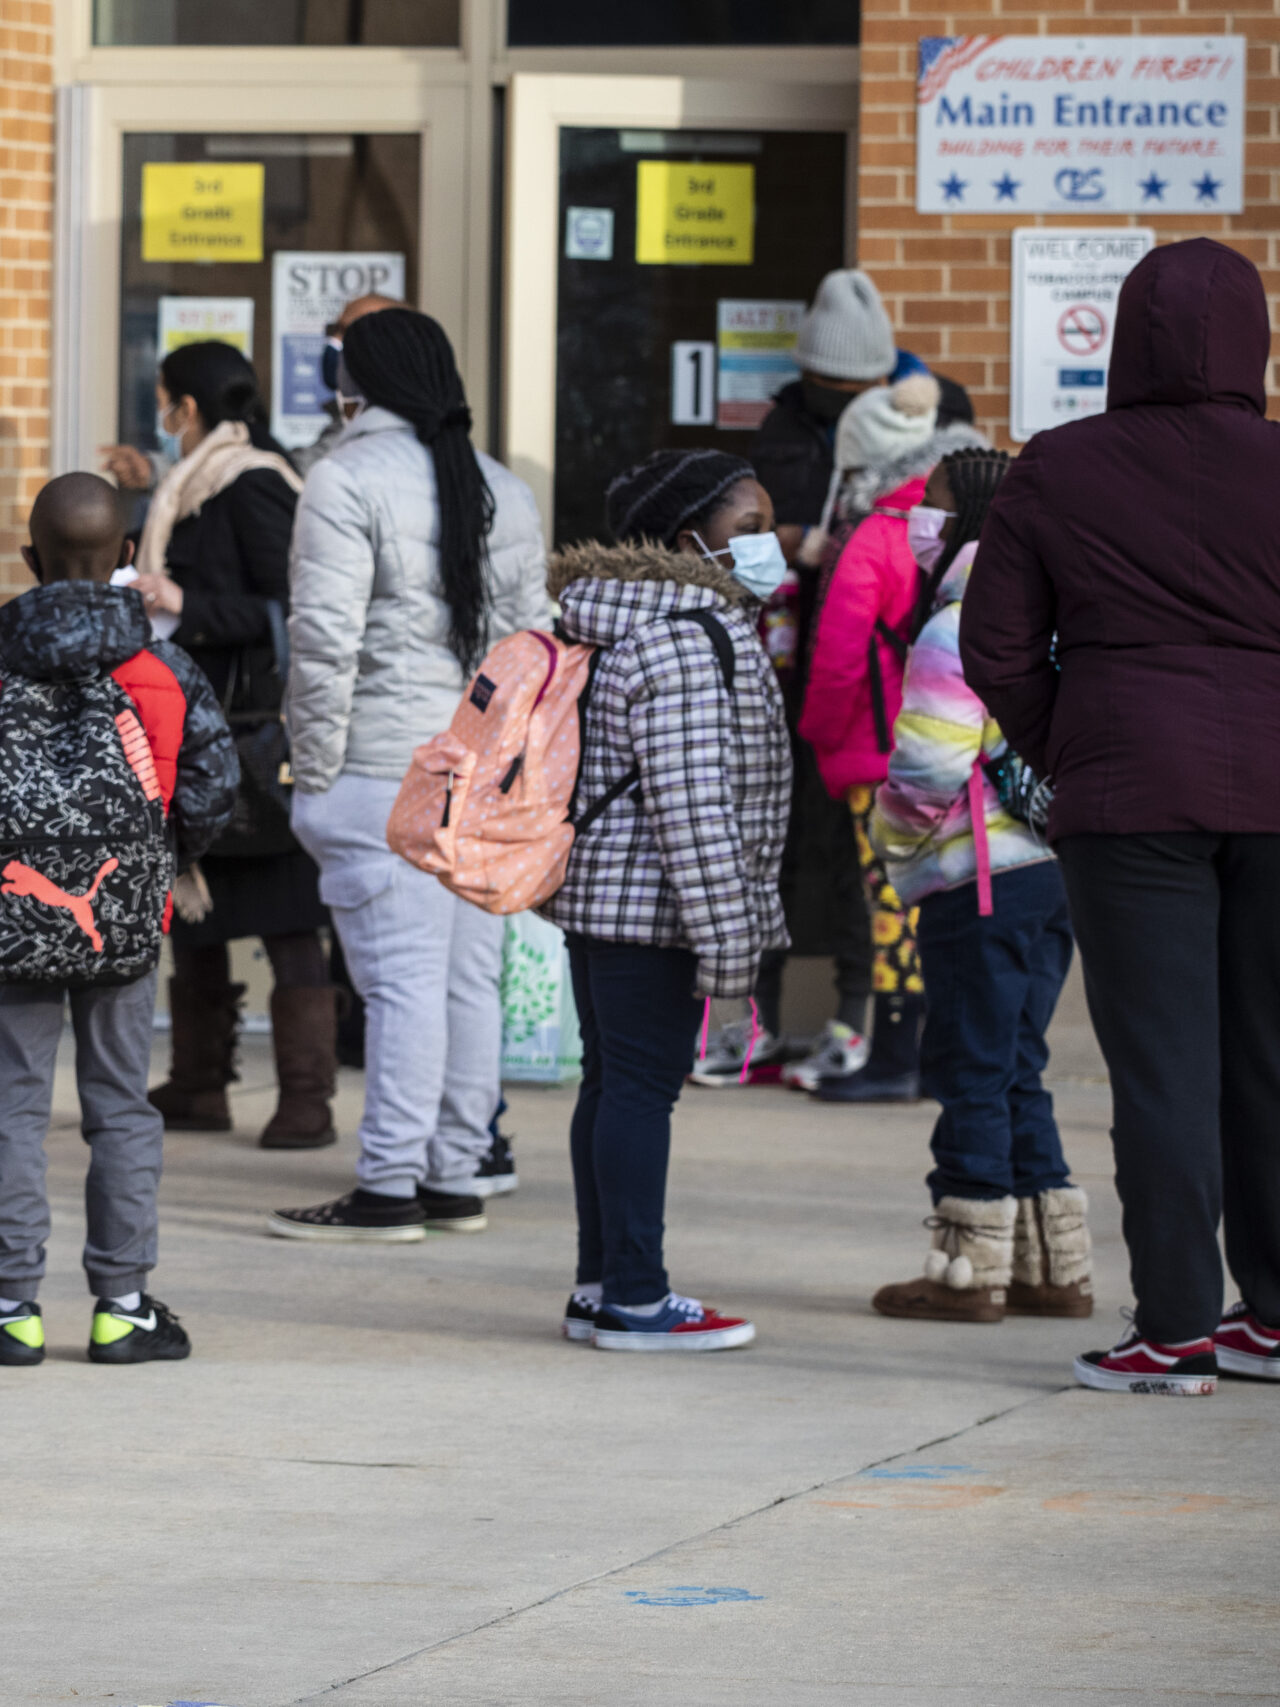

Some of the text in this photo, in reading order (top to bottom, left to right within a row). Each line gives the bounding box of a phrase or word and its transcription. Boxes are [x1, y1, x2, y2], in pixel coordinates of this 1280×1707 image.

[975, 54, 1235, 82] CHILDREN FIRST!
[935, 93, 1229, 127] Main Entrance
[937, 139, 1025, 158] BUILDING
[1032, 139, 1072, 158] FOR
[1077, 139, 1134, 158] THEIR
[181, 206, 233, 221] Grade
[674, 206, 725, 222] Grade
[1028, 241, 1140, 261] WELCOME
[288, 262, 391, 297] STOP
[688, 350, 702, 417] 1
